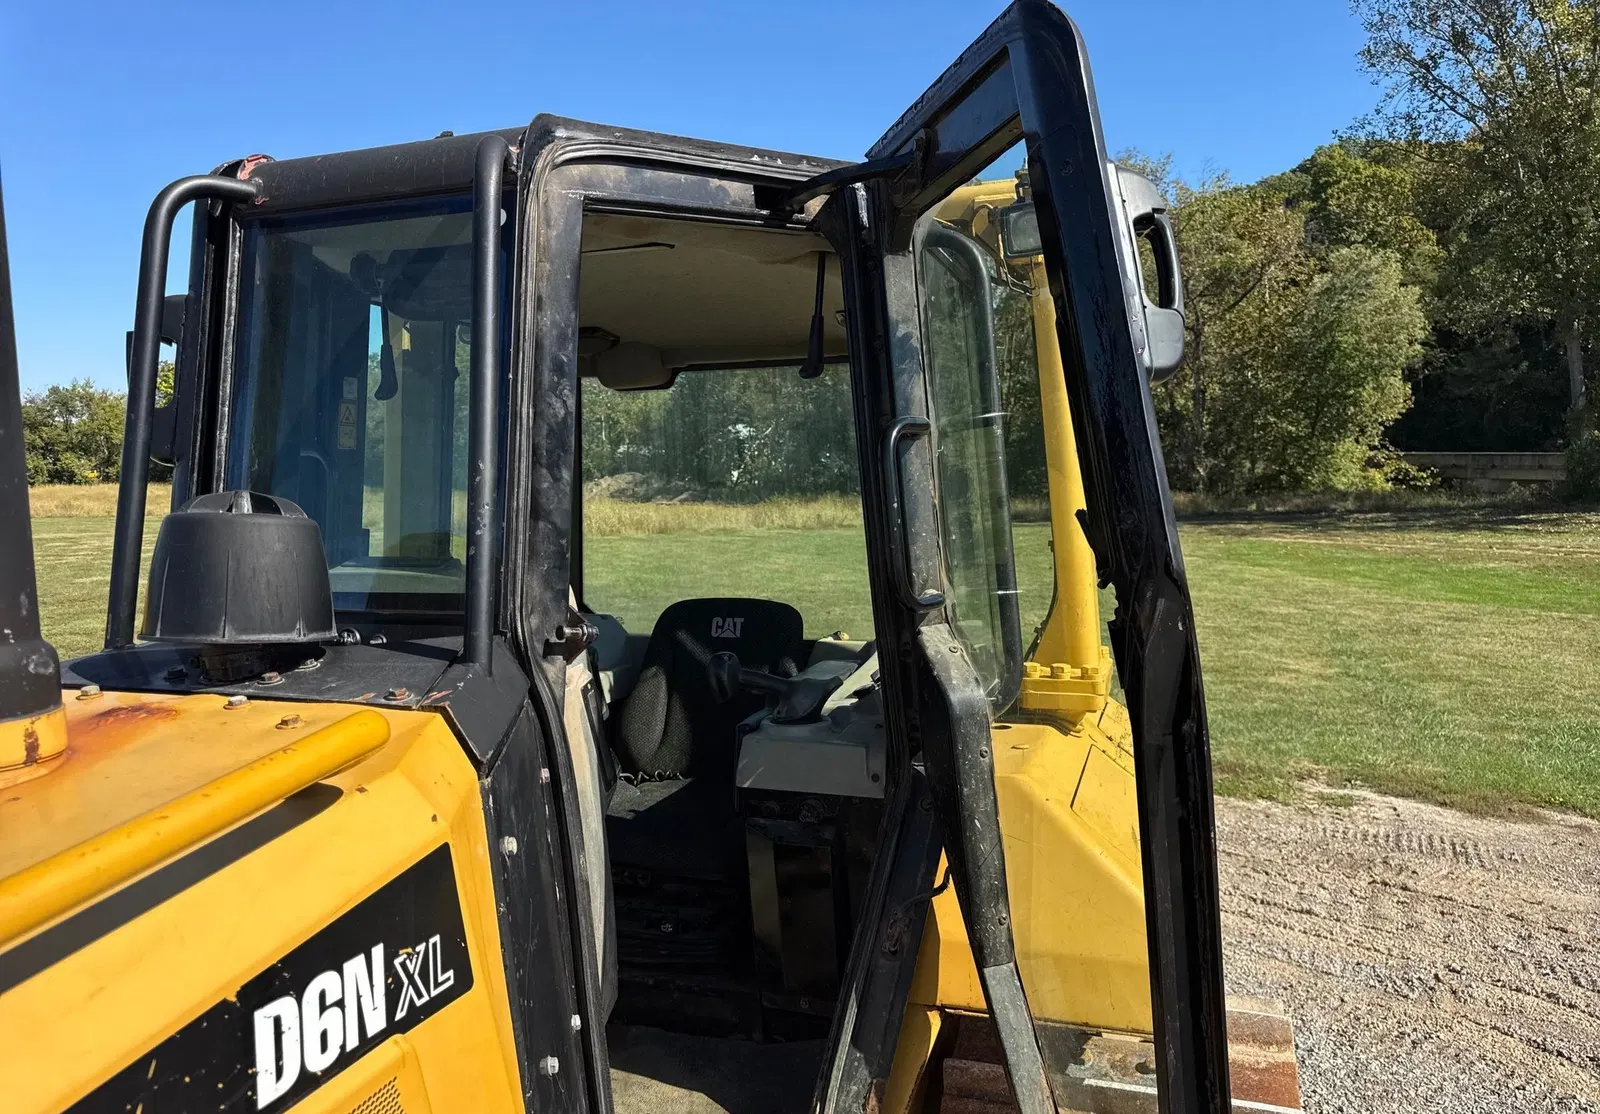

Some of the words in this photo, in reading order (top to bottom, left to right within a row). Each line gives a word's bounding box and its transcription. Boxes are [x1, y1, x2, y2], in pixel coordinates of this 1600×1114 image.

[711, 617, 744, 638] CAT
[253, 943, 388, 1111] D6N
[393, 934, 455, 1022] XL
